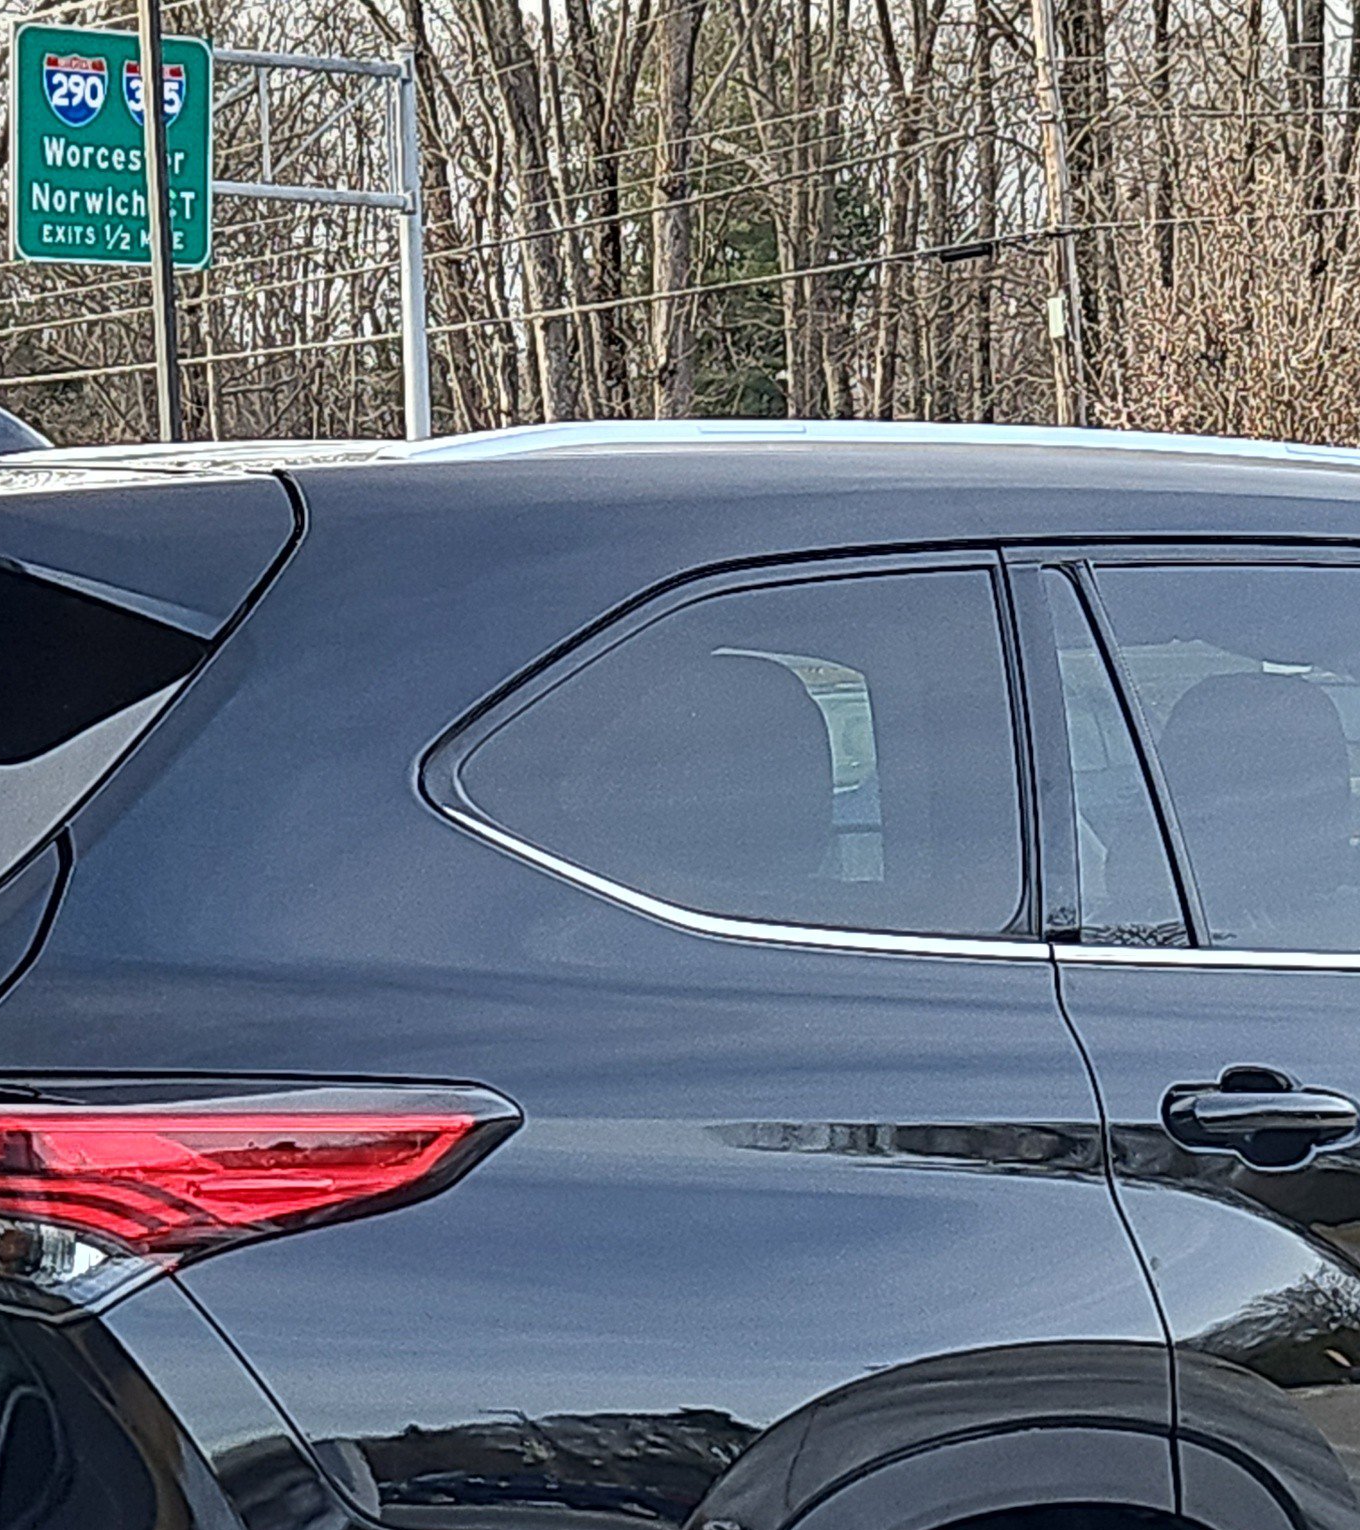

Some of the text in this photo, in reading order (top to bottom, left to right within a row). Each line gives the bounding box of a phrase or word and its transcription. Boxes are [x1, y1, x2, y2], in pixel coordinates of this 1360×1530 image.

[51, 72, 183, 114] 290 35
[43, 135, 185, 175] Worcesr
[31, 182, 146, 218] Norwich
[42, 223, 96, 245] EXITS
[140, 229, 185, 250] ME
